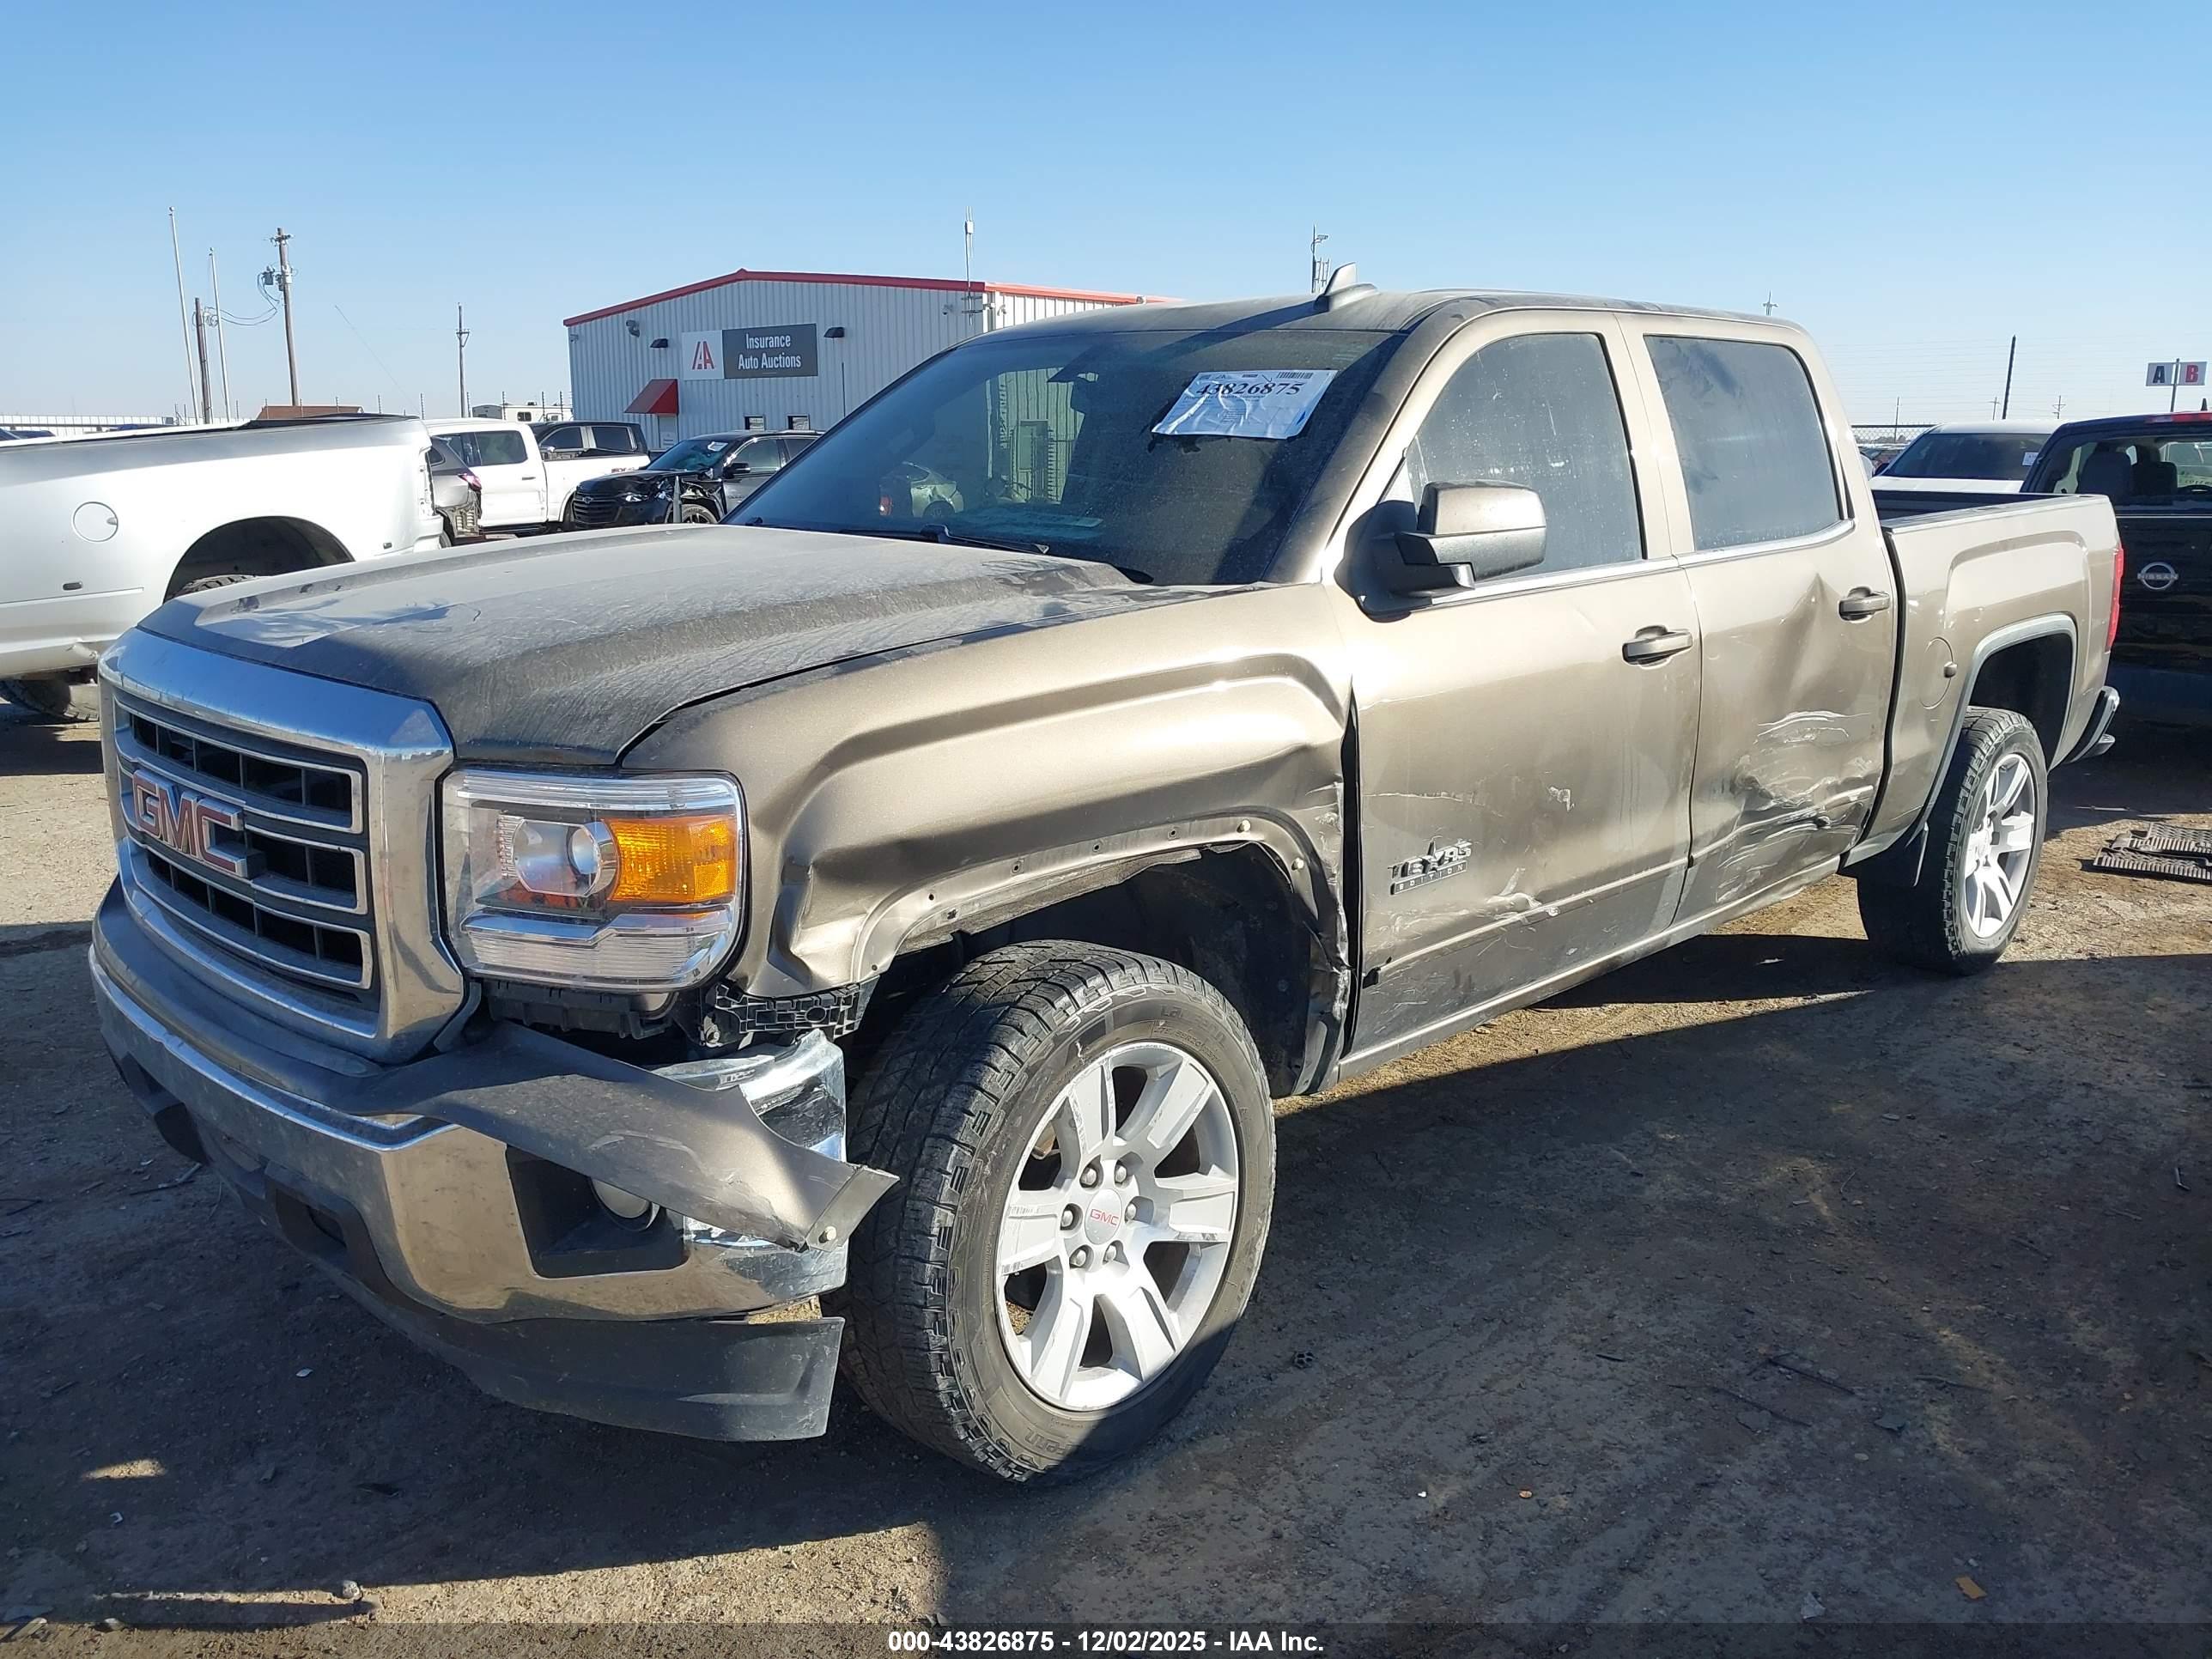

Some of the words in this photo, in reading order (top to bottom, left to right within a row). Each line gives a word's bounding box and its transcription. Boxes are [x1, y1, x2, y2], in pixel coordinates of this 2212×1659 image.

[746, 333, 791, 349] Insurance
[738, 354, 759, 370] Auto
[761, 352, 802, 369] Auctions
[2152, 365, 2166, 383] A
[2185, 364, 2199, 383] B
[1196, 382, 1306, 396] 43826875
[132, 769, 247, 878] GMC
[1398, 863, 1465, 890] EDITION
[1090, 1208, 1120, 1226] GMC
